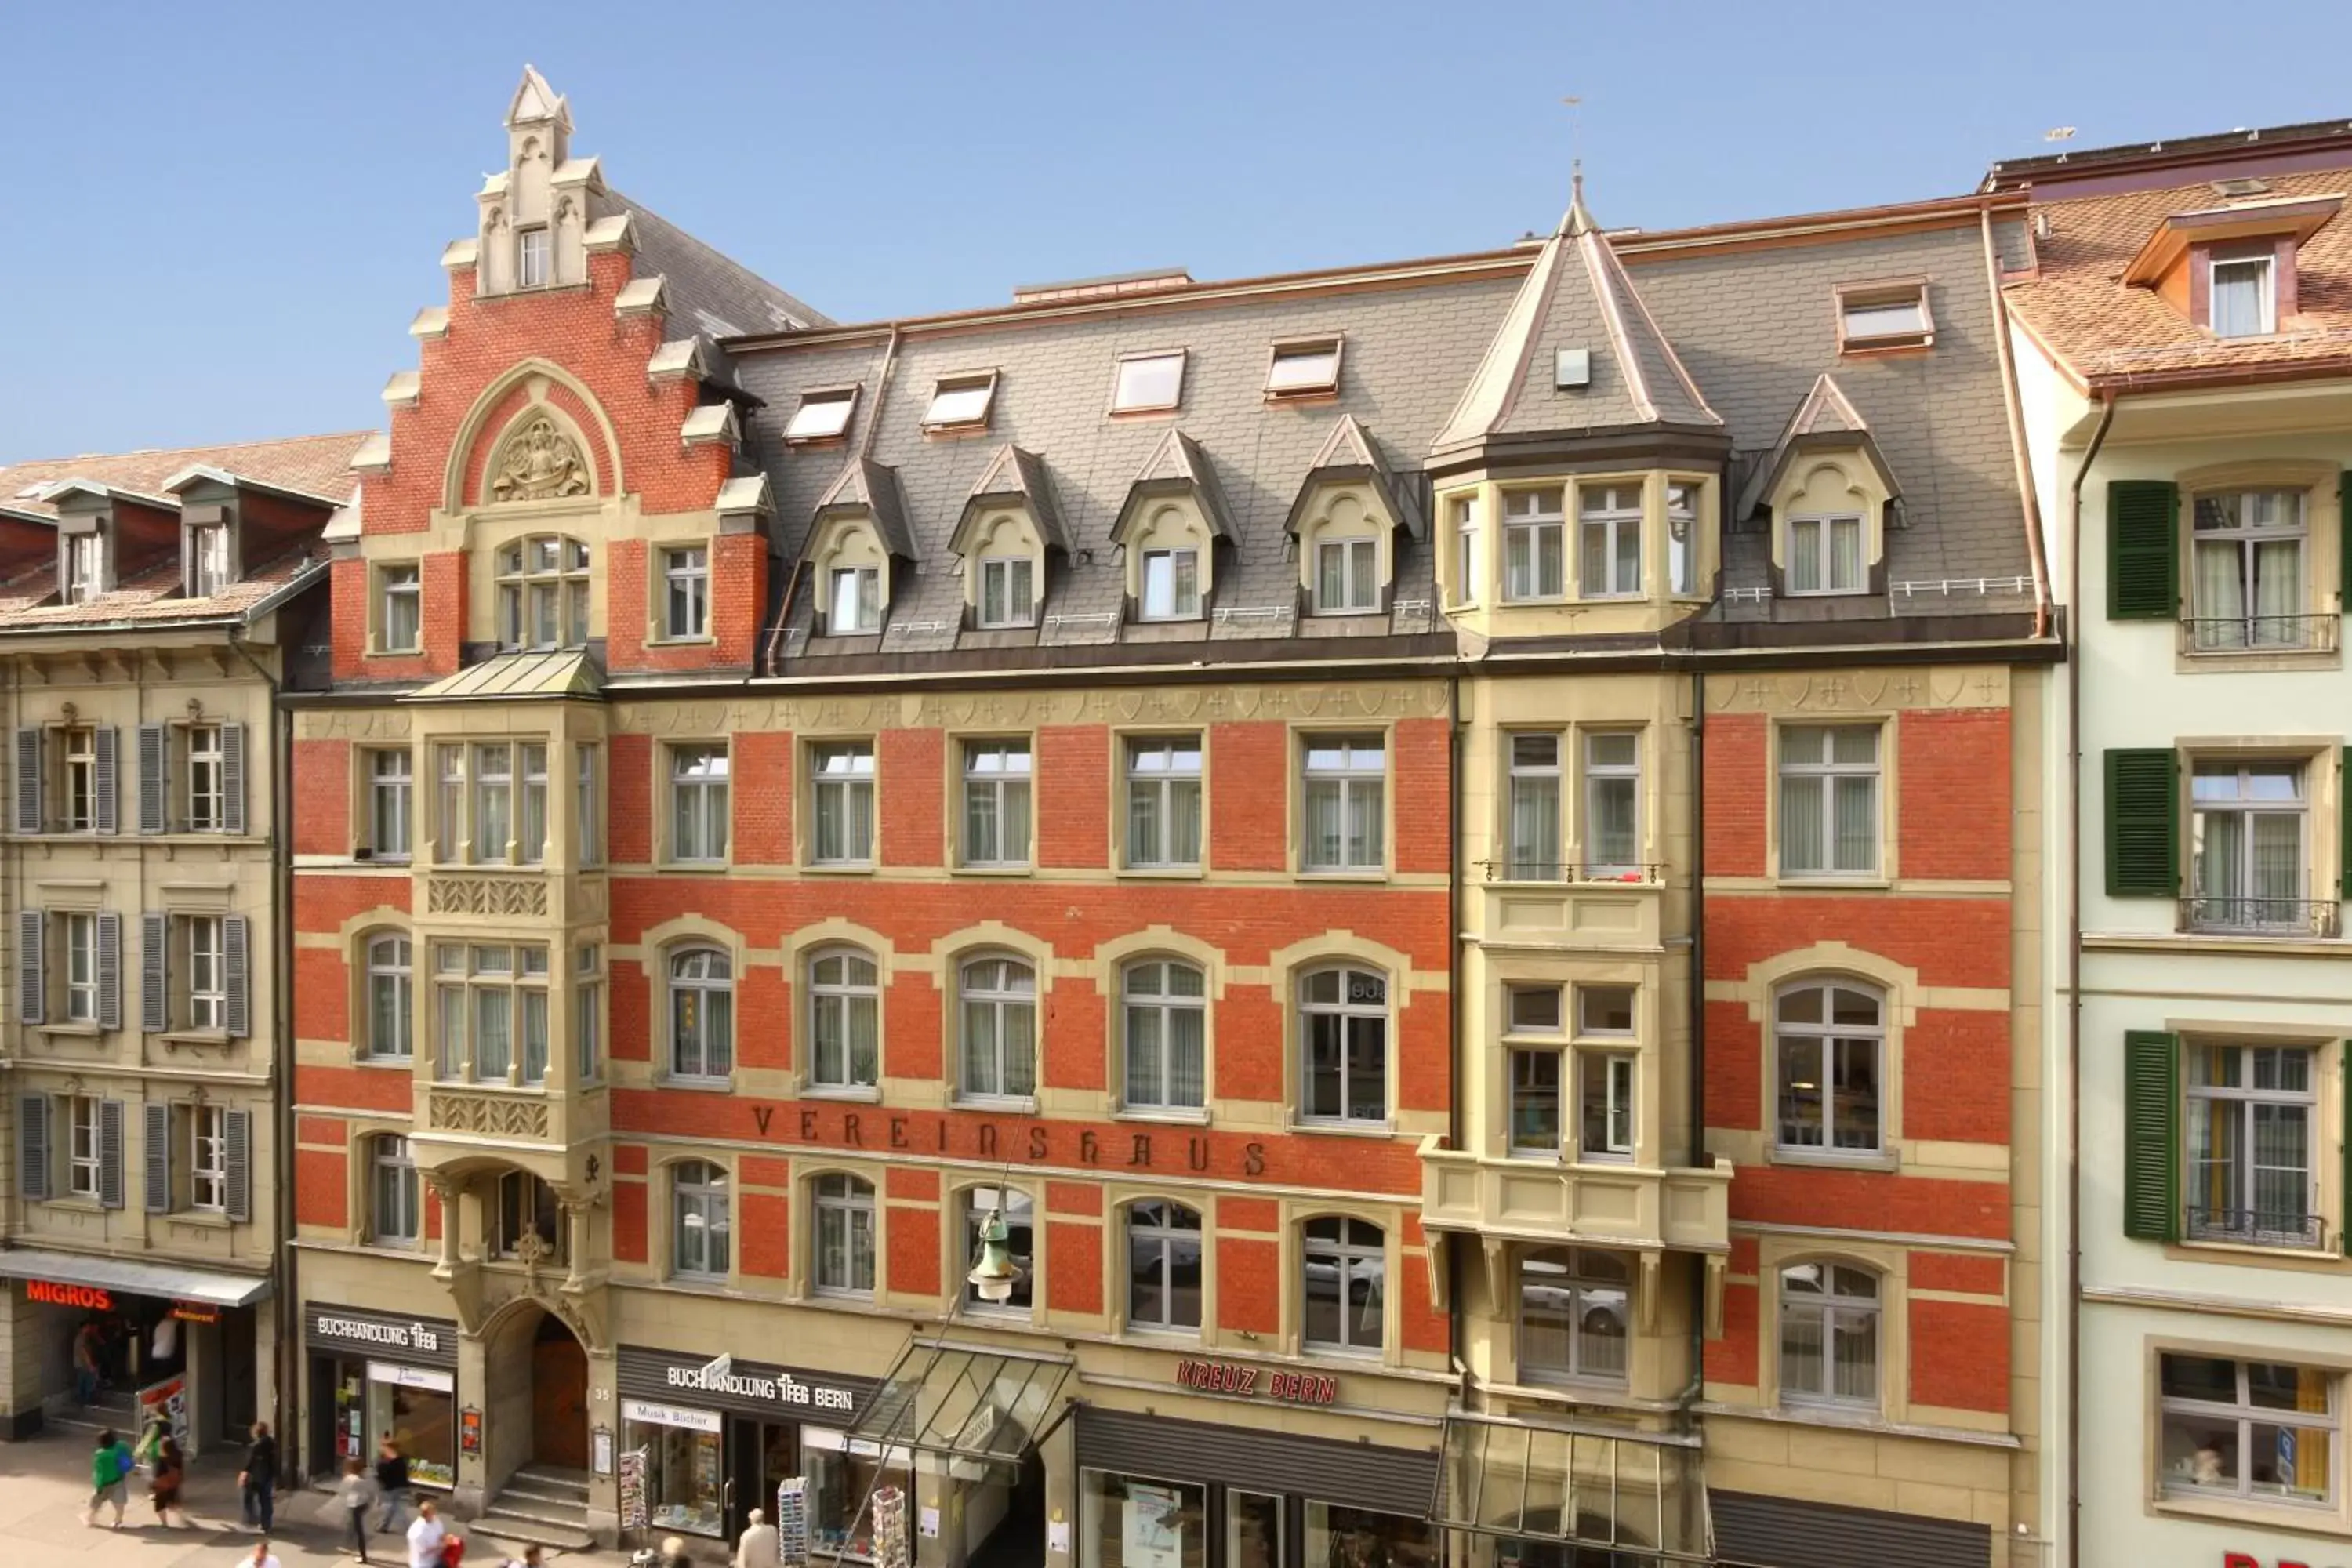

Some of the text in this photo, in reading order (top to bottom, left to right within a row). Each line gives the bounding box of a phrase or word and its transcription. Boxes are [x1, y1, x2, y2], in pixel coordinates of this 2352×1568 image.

[27, 1279, 111, 1310] MIGROS
[318, 1317, 408, 1346] BUCHHANDLUNG
[595, 1388, 609, 1400] 35
[1178, 1359, 1338, 1404] KREUZ BERN
[815, 1387, 853, 1410] BERN
[637, 1405, 666, 1419] Musik
